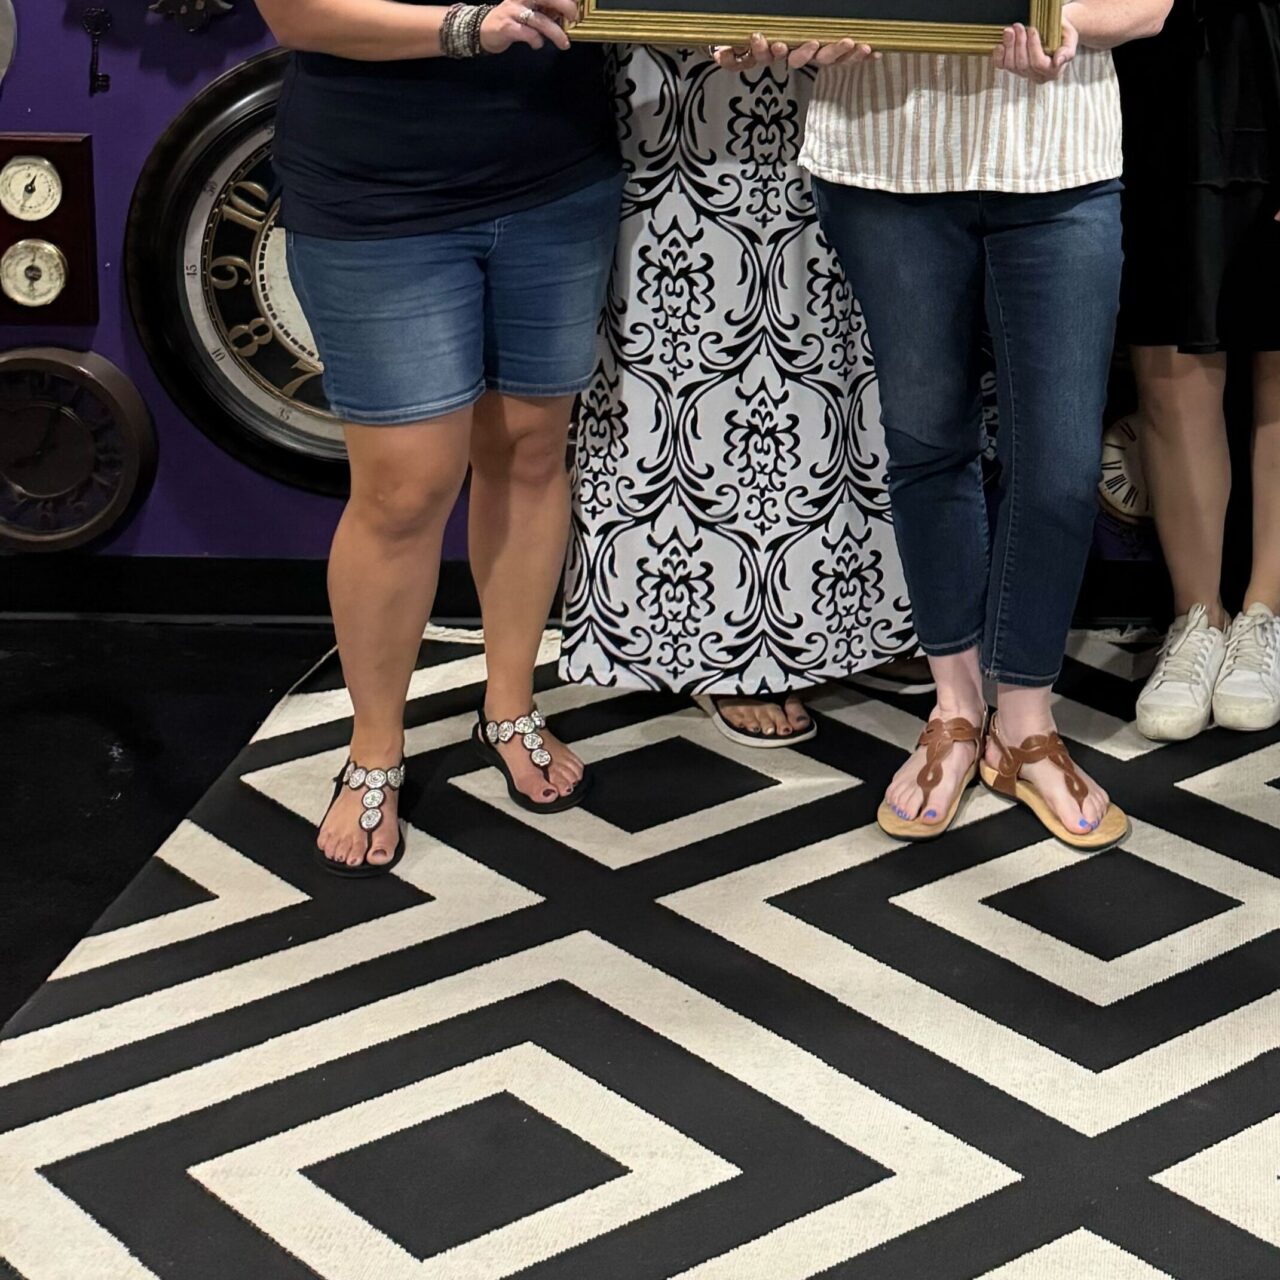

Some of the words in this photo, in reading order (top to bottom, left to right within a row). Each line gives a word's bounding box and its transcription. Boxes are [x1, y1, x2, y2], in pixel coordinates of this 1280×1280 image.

[221, 180, 270, 233] 10
[210, 255, 254, 290] 9
[228, 317, 273, 358] 8
[281, 356, 325, 398] 7
